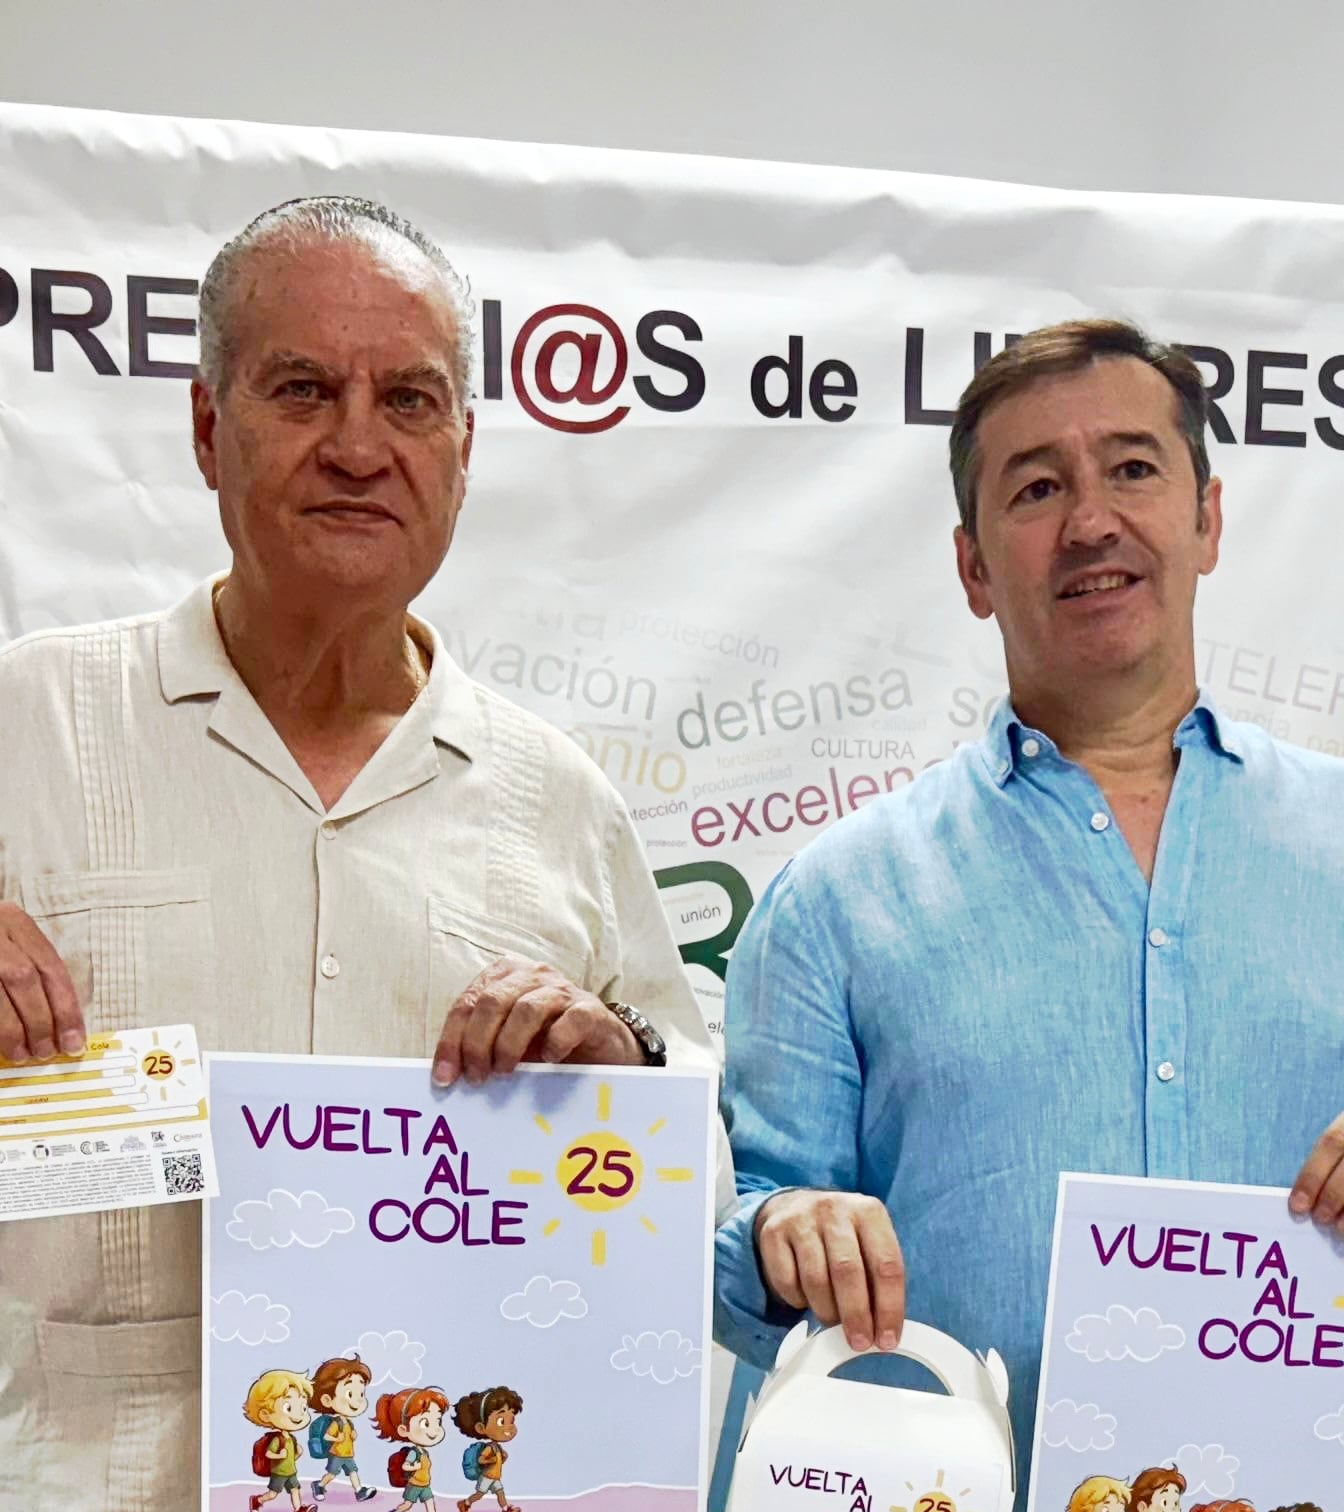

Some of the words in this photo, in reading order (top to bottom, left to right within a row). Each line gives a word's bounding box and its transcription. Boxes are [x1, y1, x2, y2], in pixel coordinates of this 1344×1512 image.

[750, 334, 858, 423] de
[676, 667, 914, 752] defensa
[810, 736, 915, 761] CULTURA
[241, 1103, 458, 1156] VUELTA
[424, 1151, 490, 1195] AL
[566, 1146, 635, 1198] 25
[368, 1197, 529, 1246] COLE
[1090, 1223, 1289, 1279] VUELTA
[1253, 1276, 1315, 1320] AL
[770, 1463, 868, 1496] VUELTA
